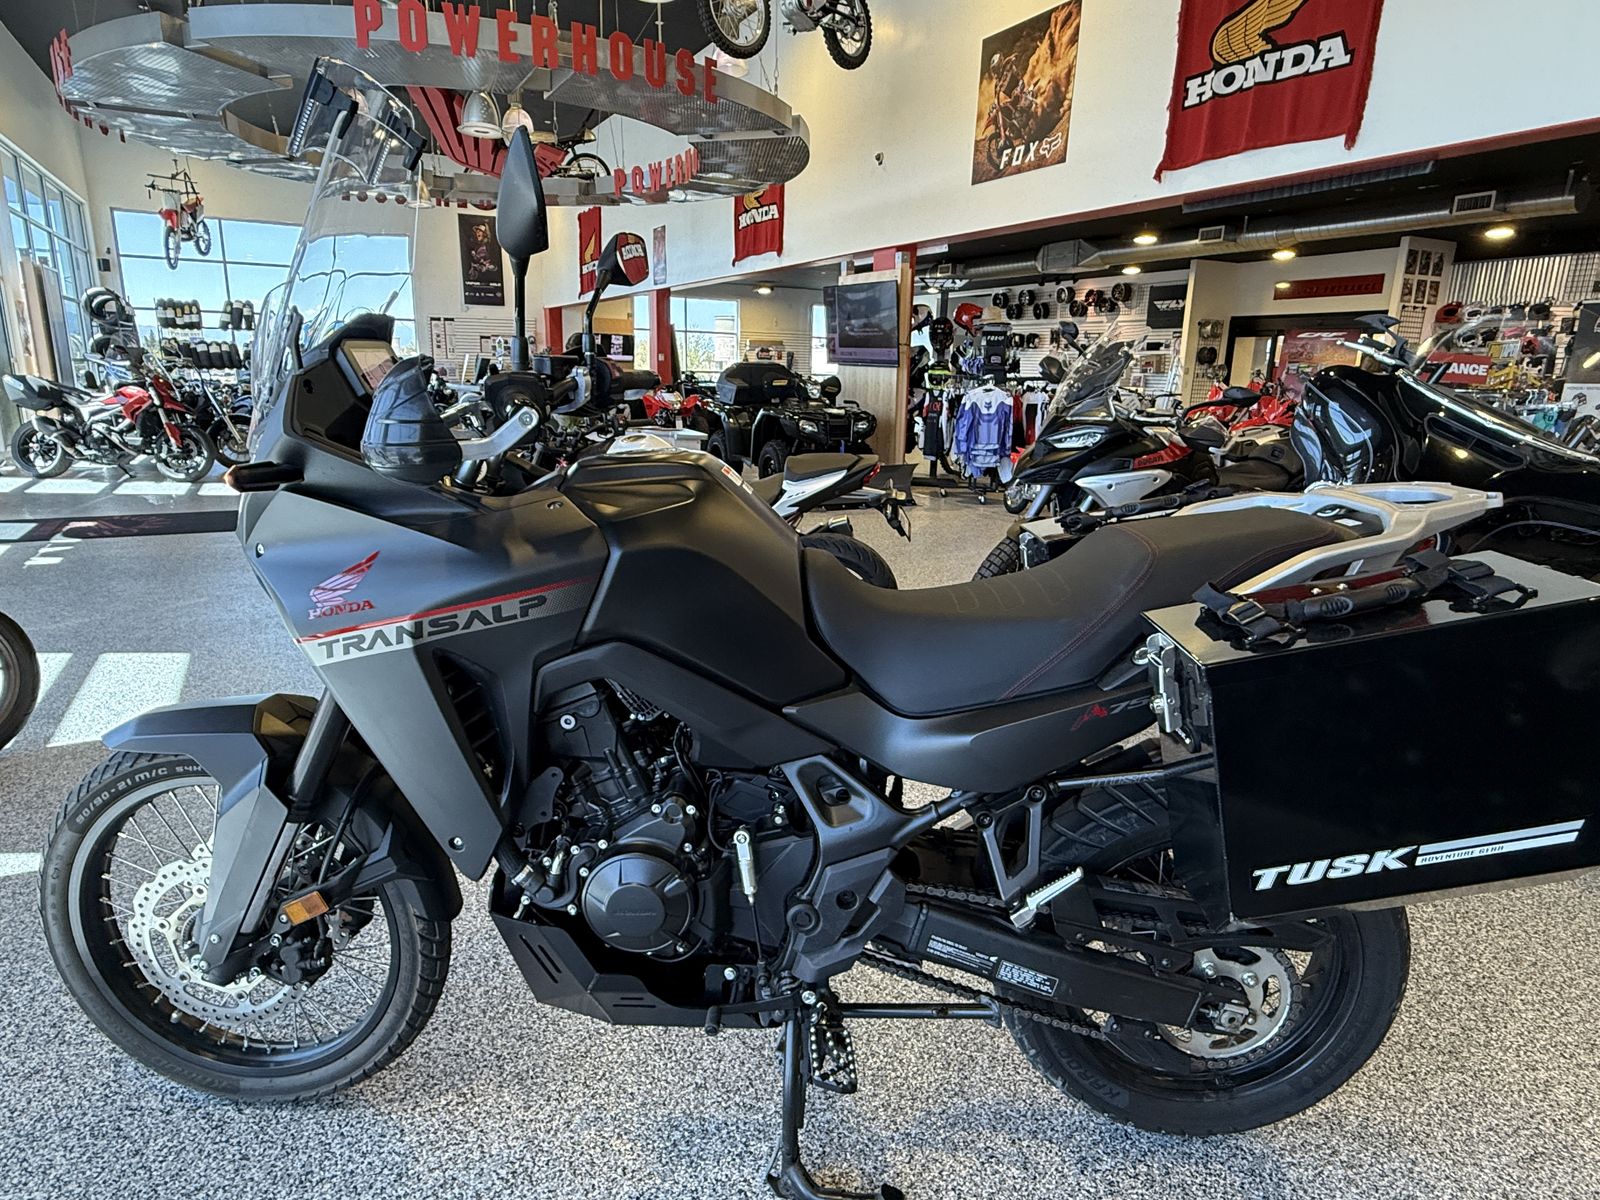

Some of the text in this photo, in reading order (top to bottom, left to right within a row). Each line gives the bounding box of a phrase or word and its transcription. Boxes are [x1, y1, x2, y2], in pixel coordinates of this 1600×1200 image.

[353, 0, 718, 103] POWERHOUSE
[1183, 36, 1351, 107] HONDA
[999, 140, 1040, 170] FOX
[738, 204, 780, 230] HONDA
[308, 599, 376, 620] HONDA
[317, 594, 547, 659] TRANSALP
[1252, 845, 1419, 892] TUSK
[1420, 844, 1505, 864] ADVENTURE GEAR
